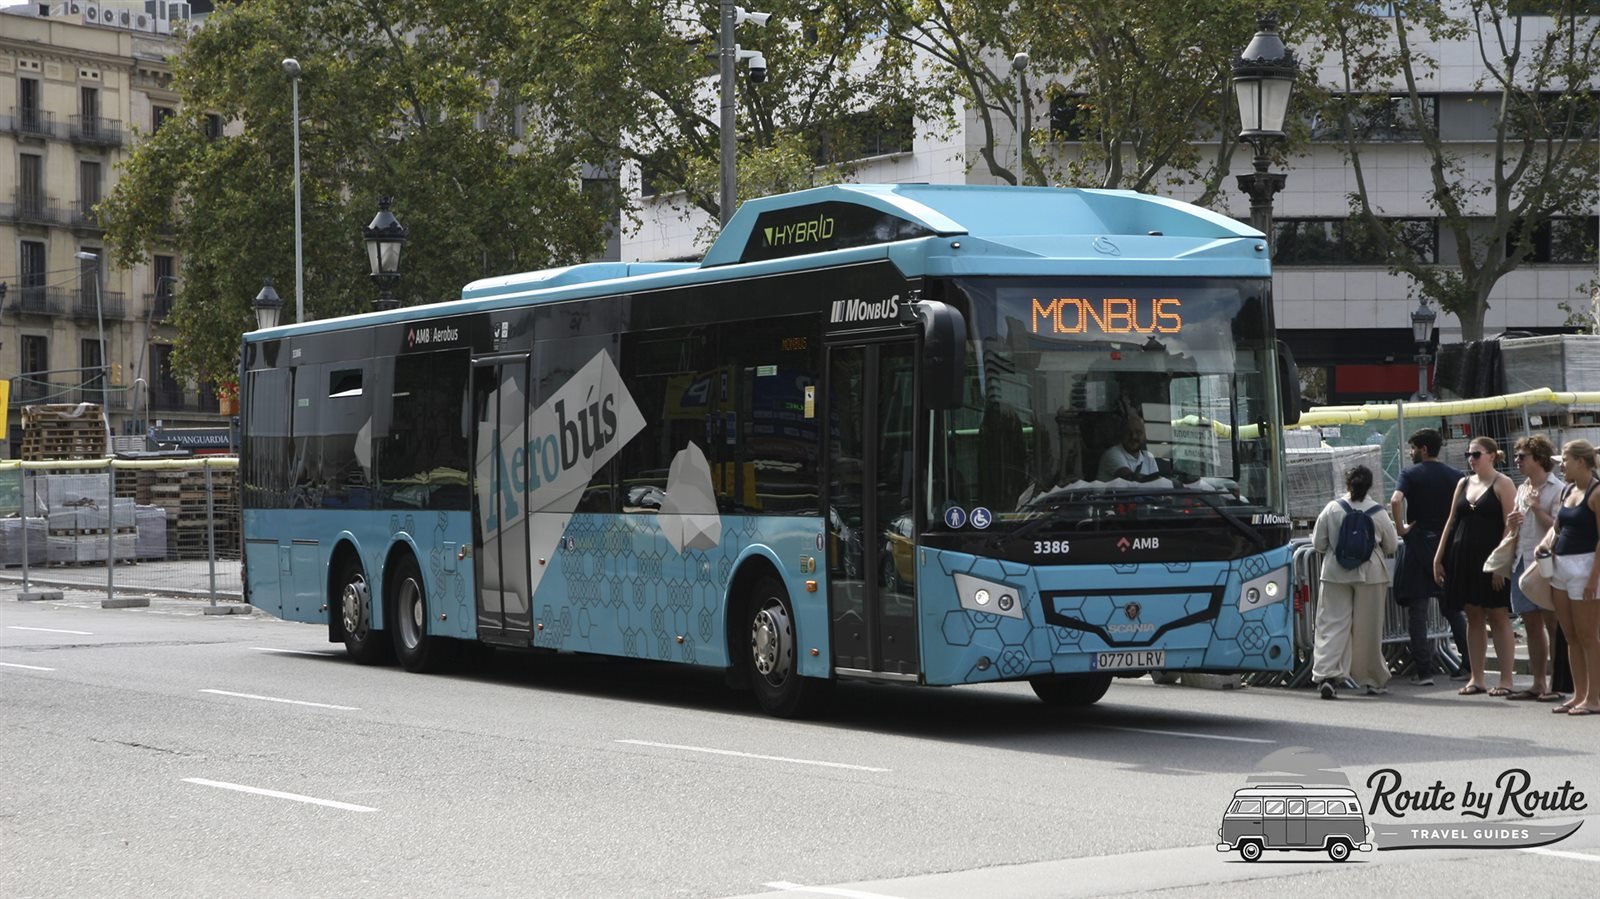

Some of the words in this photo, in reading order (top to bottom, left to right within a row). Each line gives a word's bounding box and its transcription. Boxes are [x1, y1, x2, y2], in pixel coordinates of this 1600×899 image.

[774, 213, 834, 246] HYBRID
[1032, 298, 1182, 334] MONBUS
[415, 328, 430, 344] AMB
[433, 325, 458, 342] Aerobus
[177, 435, 229, 444] VANGUARDIA
[486, 384, 617, 533] Aerobús
[1033, 541, 1070, 554] 3386
[1132, 537, 1159, 550] AMB
[1107, 623, 1156, 633] SCANIA
[1100, 652, 1133, 667] 0770
[1137, 651, 1162, 666] LRV
